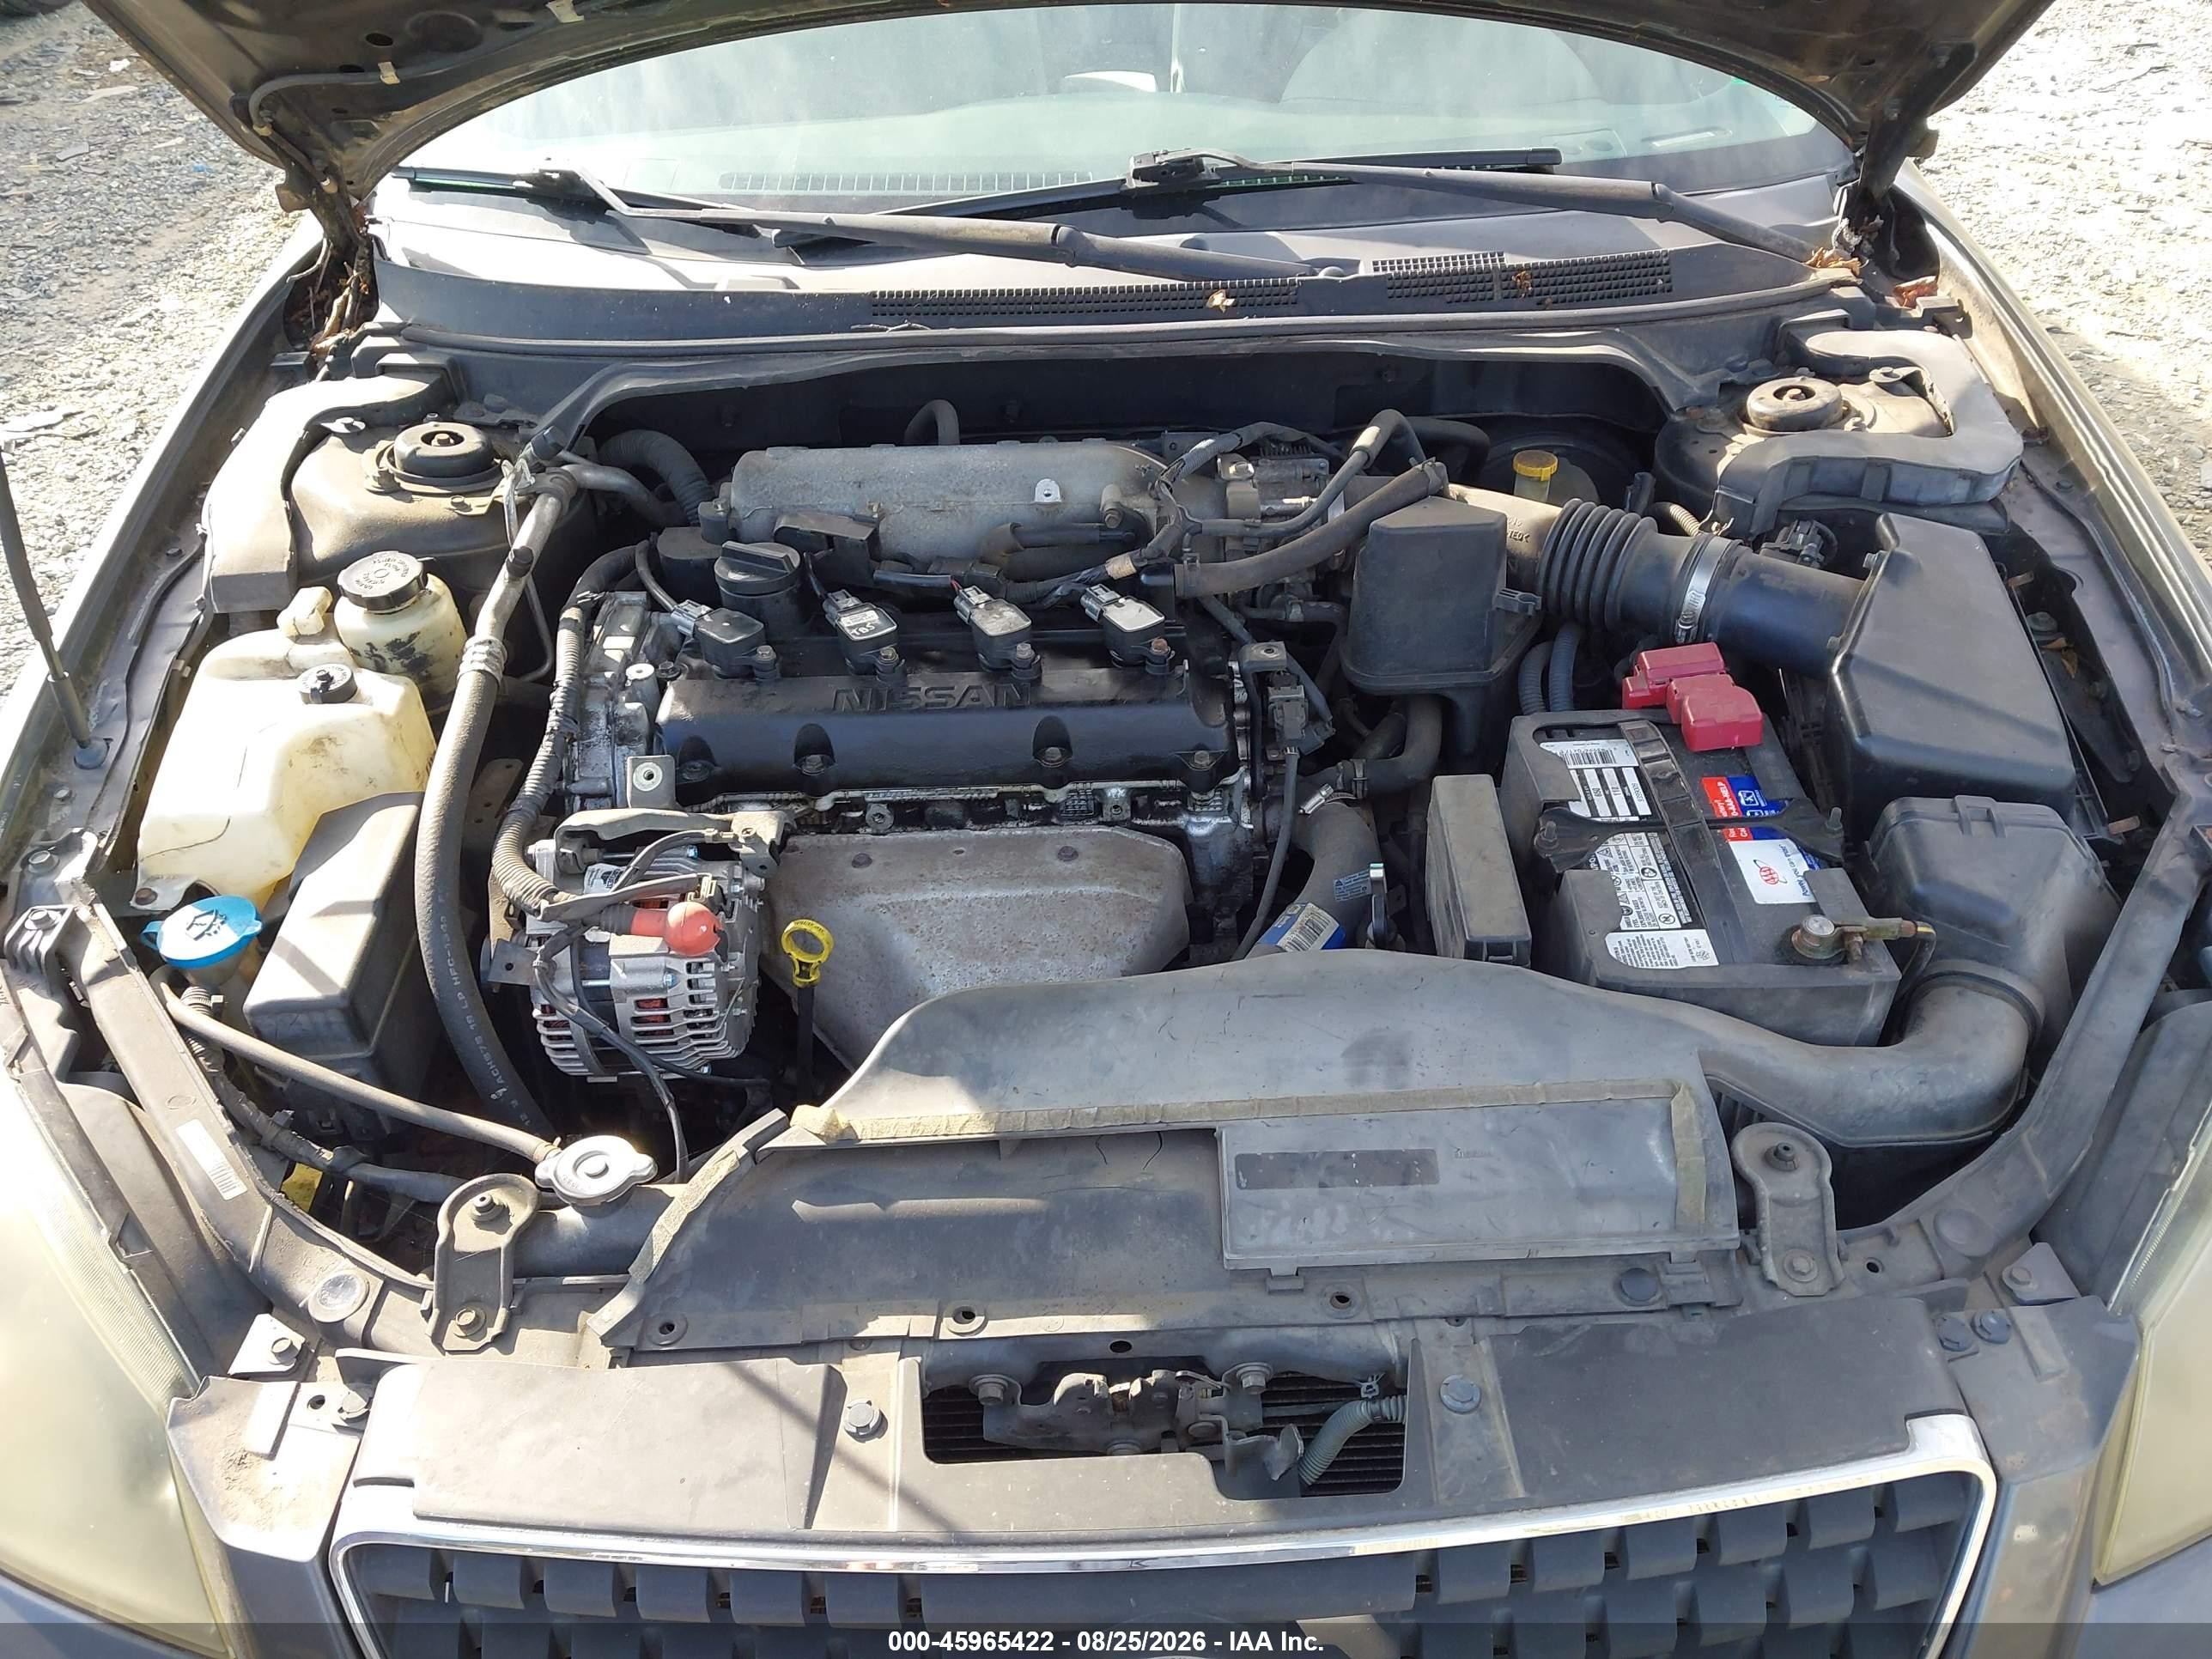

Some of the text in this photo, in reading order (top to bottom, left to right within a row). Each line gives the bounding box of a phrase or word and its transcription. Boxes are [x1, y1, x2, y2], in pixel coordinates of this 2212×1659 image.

[832, 684, 1031, 712] NISSAN
[1786, 858, 1796, 868] can
[1759, 866, 1778, 884] AAA
[1792, 868, 1802, 878] you
[458, 992, 470, 1010] LP
